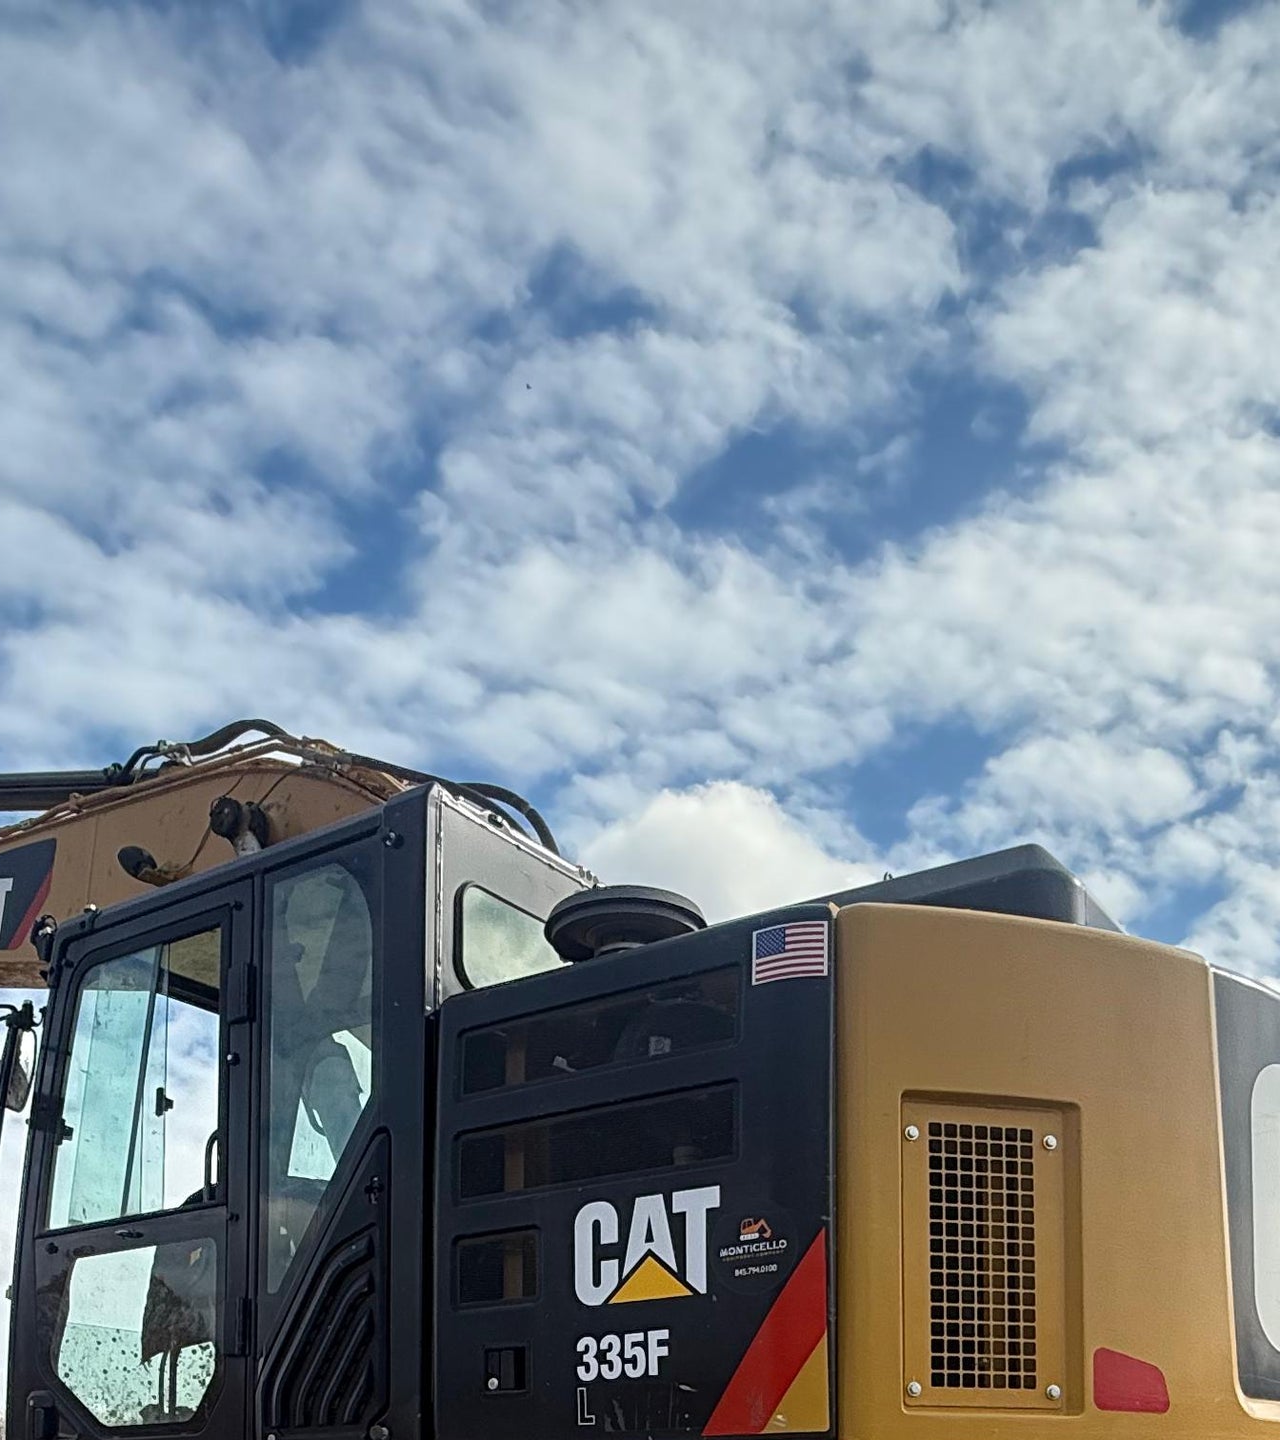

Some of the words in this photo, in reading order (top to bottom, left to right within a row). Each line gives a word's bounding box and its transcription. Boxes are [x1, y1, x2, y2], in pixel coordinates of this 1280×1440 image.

[574, 1185, 720, 1306] CAT
[719, 1239, 787, 1258] MONTICELLO
[576, 1329, 670, 1382] 335F
[577, 1387, 596, 1426] L
